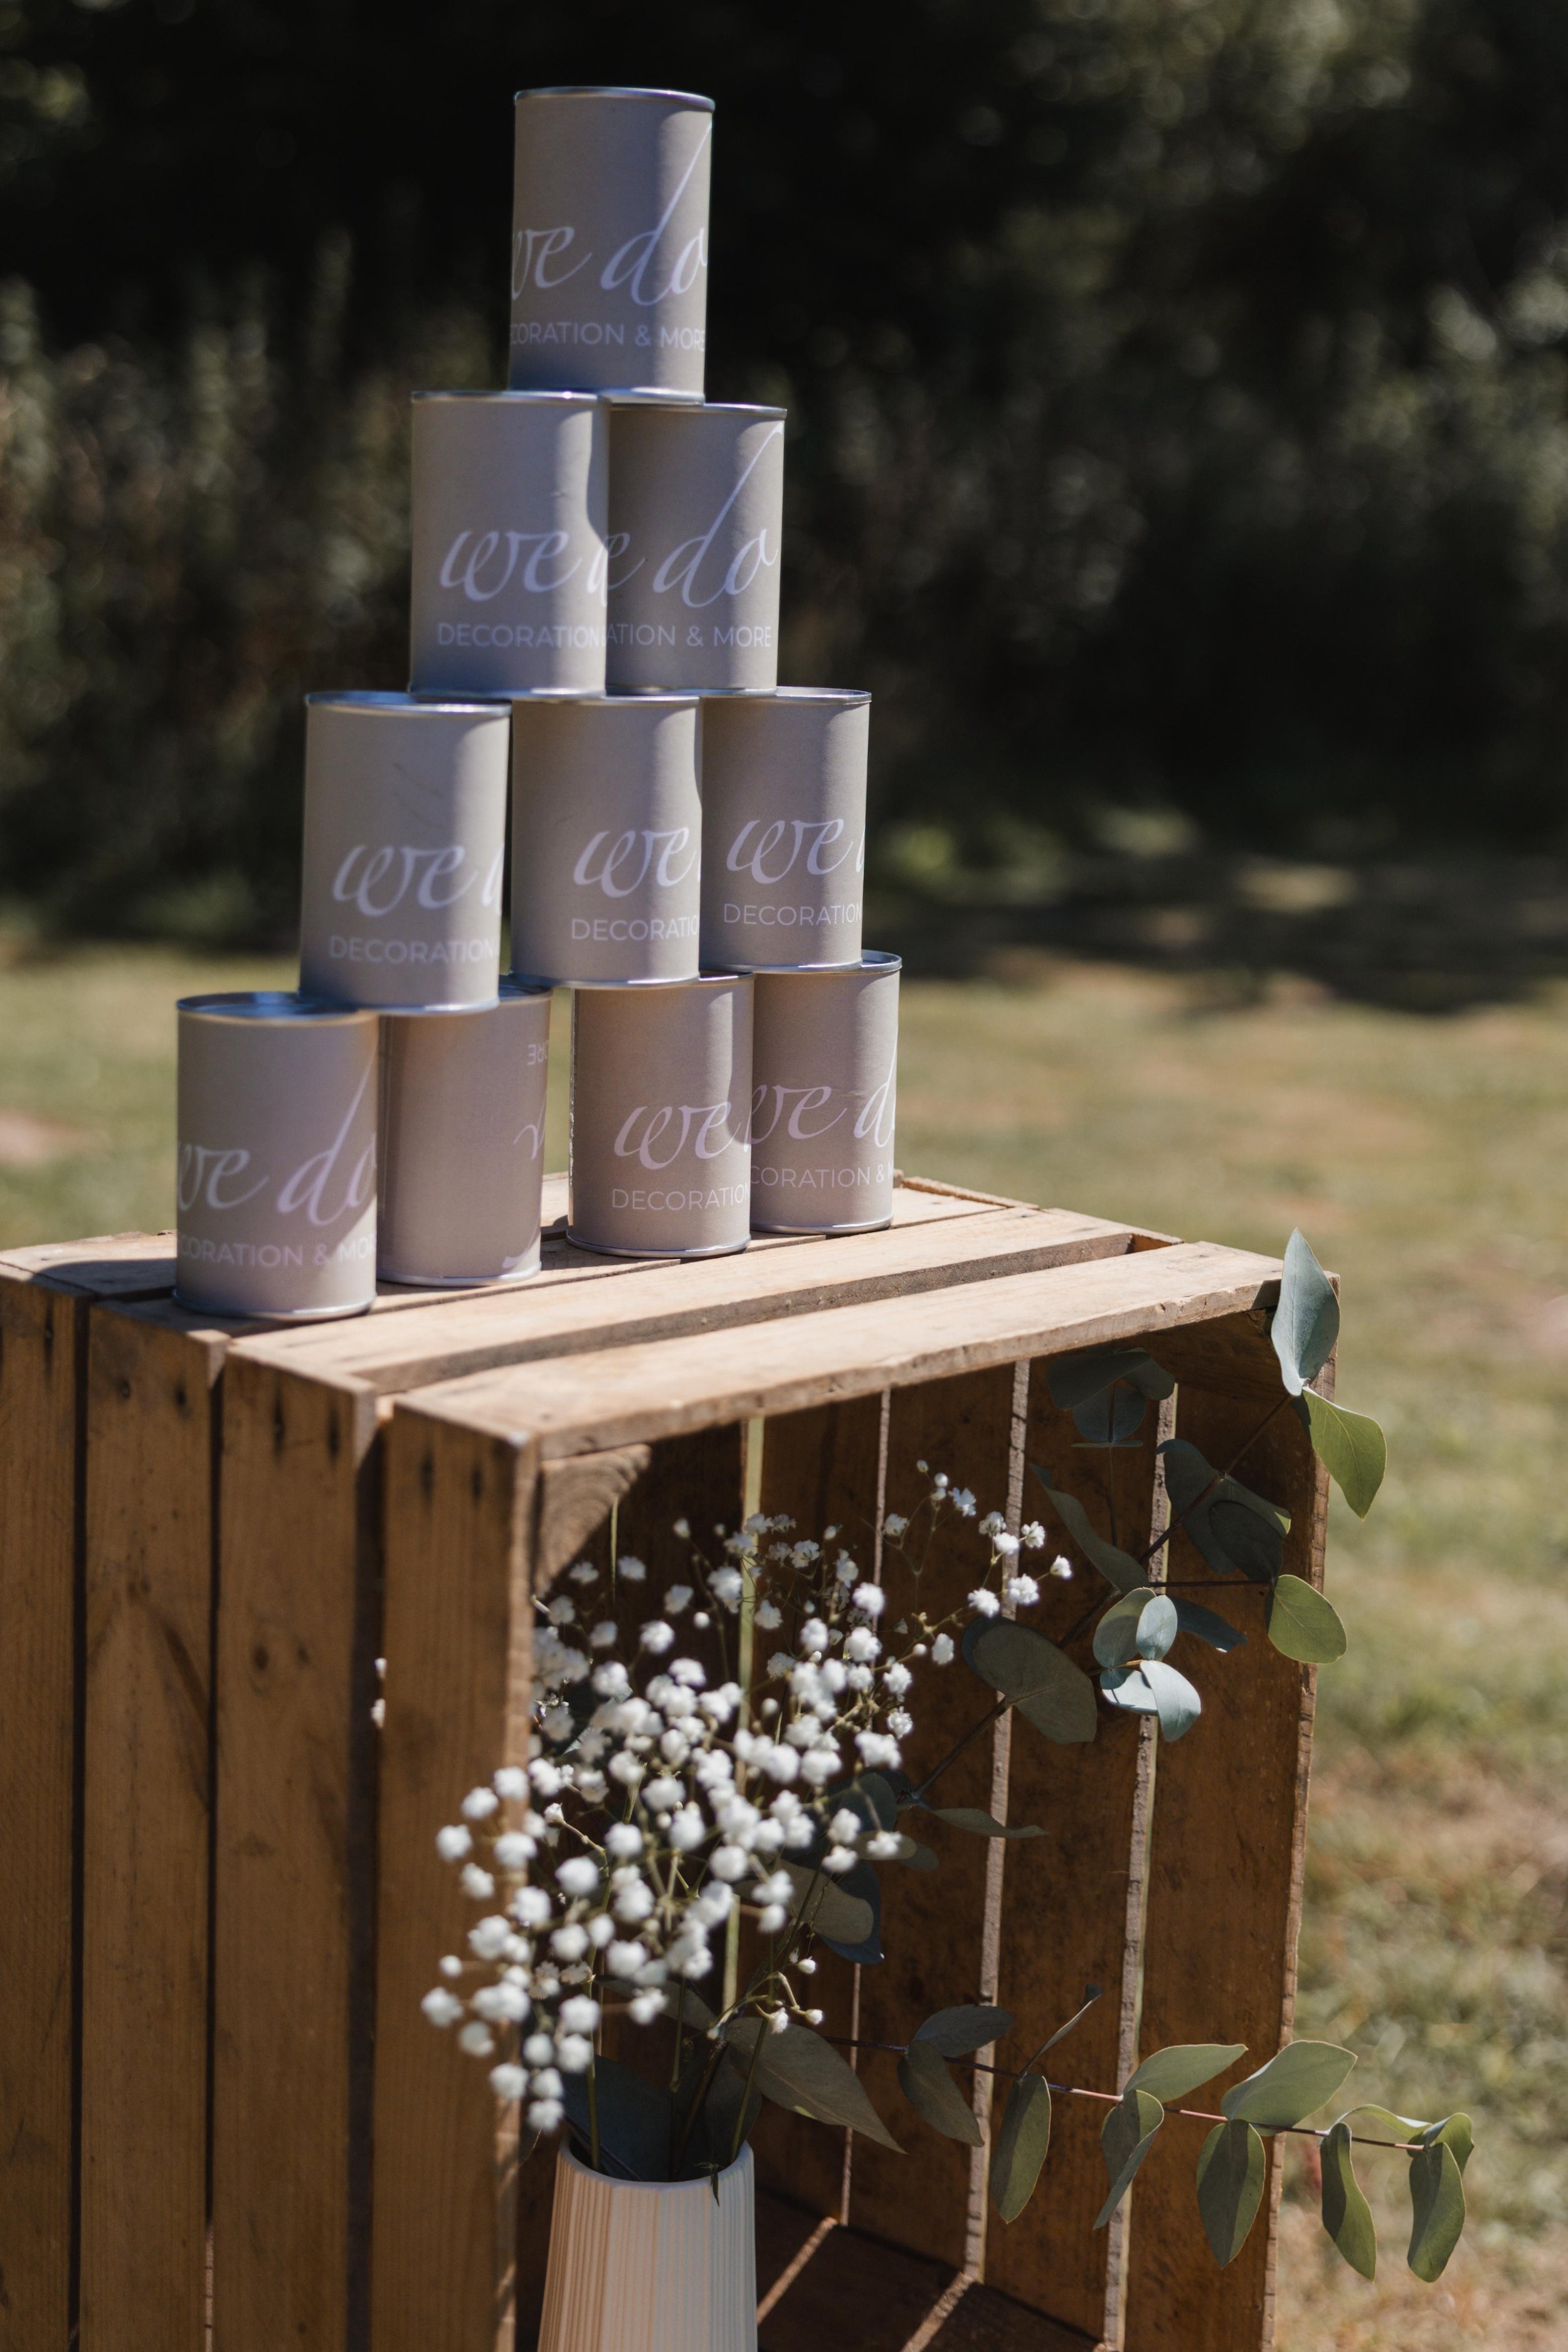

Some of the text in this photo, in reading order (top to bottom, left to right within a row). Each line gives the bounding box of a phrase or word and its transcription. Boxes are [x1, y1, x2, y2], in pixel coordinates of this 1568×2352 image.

[635, 325, 652, 347] &
[652, 423, 783, 608] do
[440, 531, 583, 601] we
[438, 622, 600, 649] DECORATION
[607, 623, 772, 647] ATION & MORE
[574, 827, 697, 898] we
[726, 818, 854, 884] we
[332, 845, 479, 918] we
[571, 915, 699, 941] DECORATIO
[614, 1101, 741, 1170] we
[751, 1165, 871, 1189] CORATION
[876, 1163, 885, 1184] &
[315, 1244, 329, 1266] &
